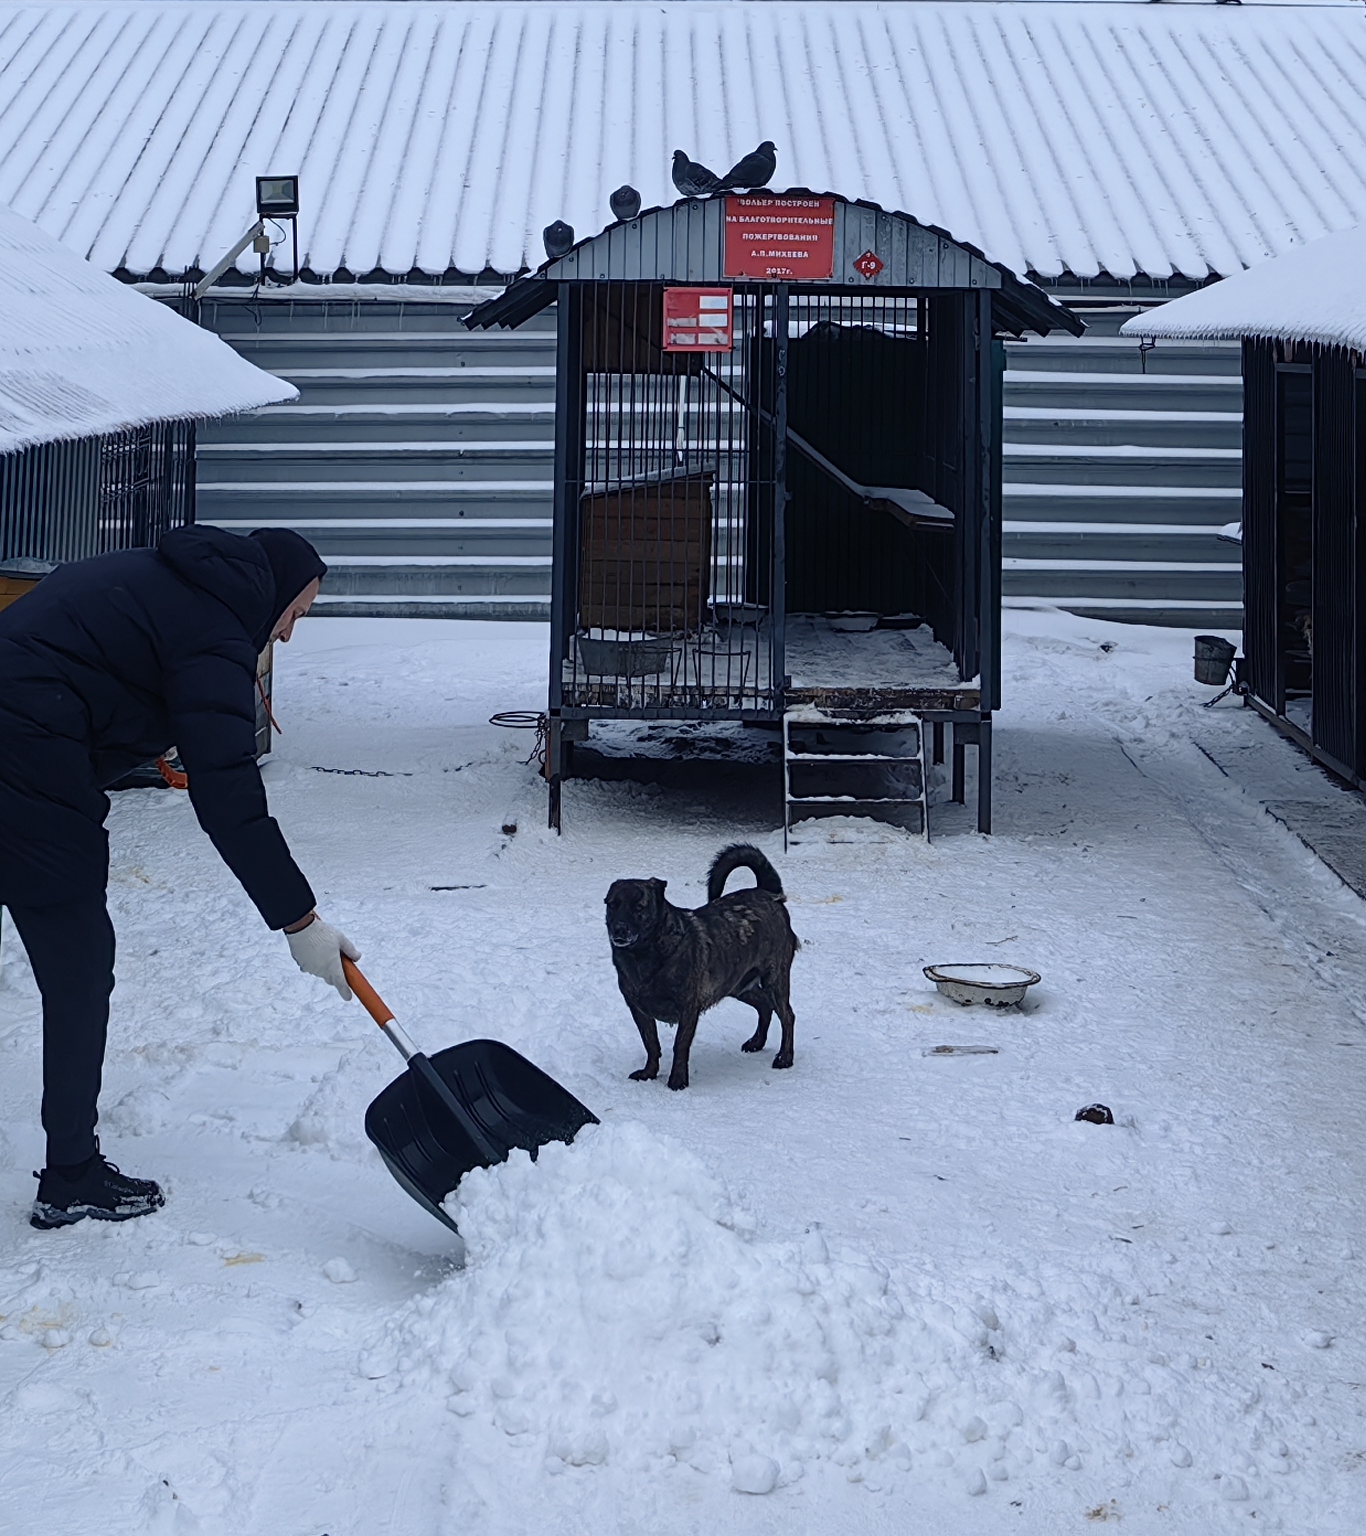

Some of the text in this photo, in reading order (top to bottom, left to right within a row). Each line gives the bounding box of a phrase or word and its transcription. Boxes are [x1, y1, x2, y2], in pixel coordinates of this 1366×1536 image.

[738, 198, 820, 208] ВОЛЬЕР ПОСТРОЕН
[726, 215, 834, 225] НА БЛАГОТВОРИТЕЛЬНЫЕ
[861, 261, 876, 270] Г-9
[765, 267, 793, 276] 2017г.
